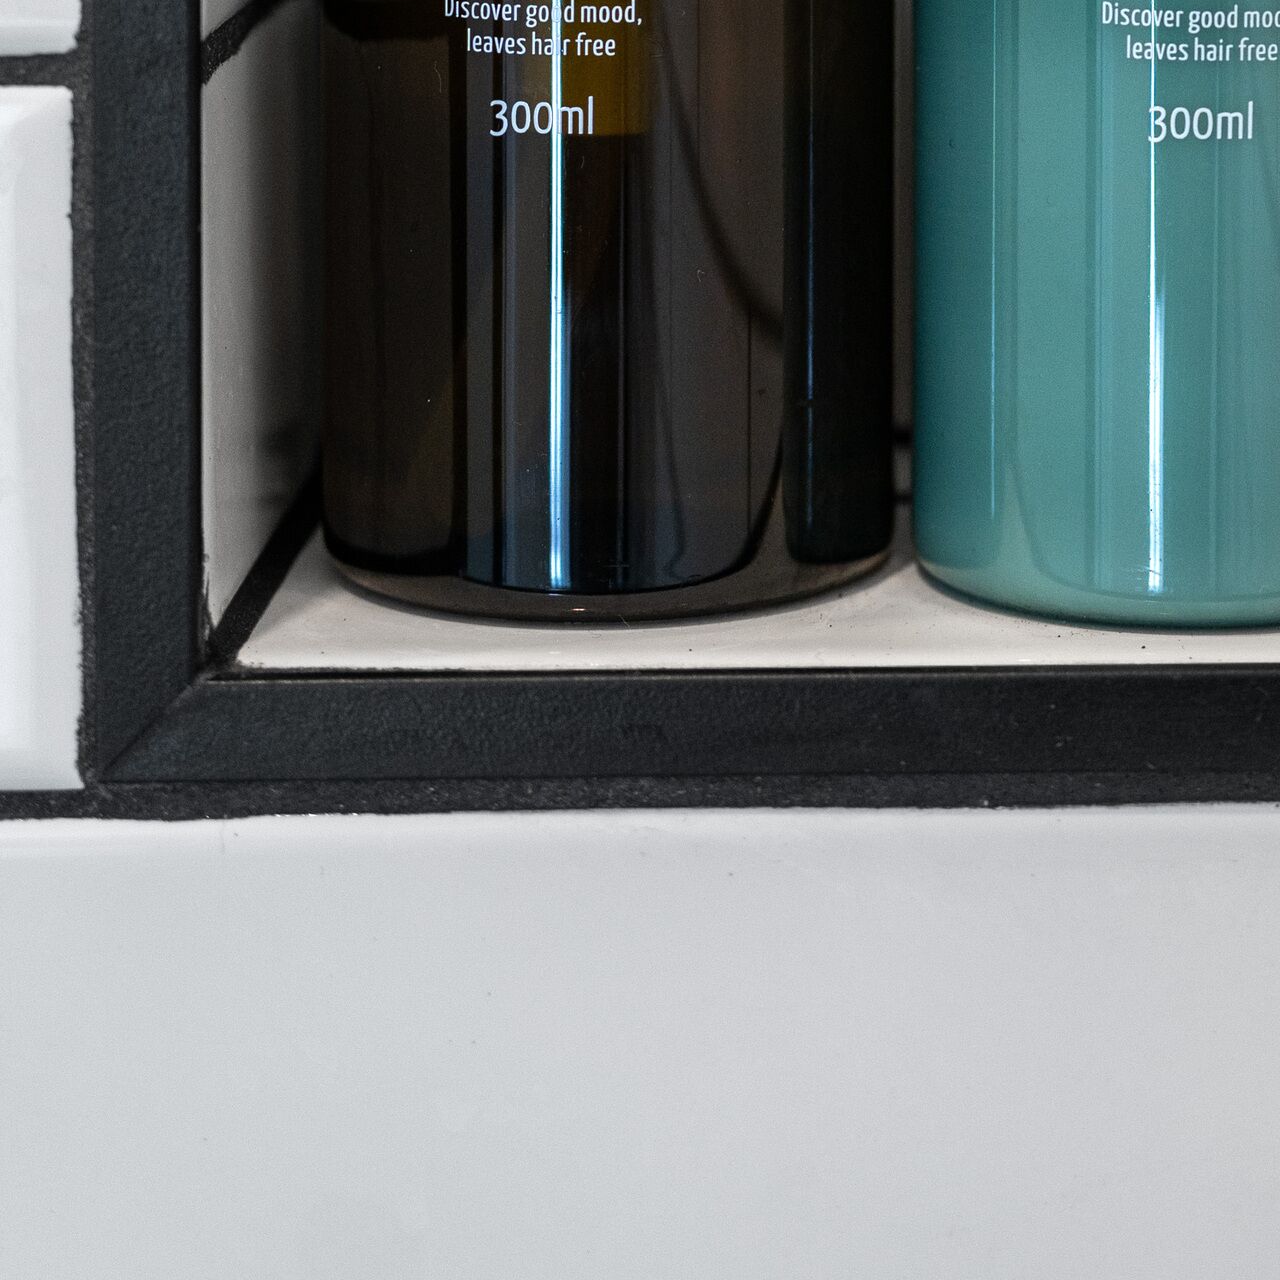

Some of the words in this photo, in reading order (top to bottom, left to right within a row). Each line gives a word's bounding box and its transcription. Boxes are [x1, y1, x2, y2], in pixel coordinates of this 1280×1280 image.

[1101, 0, 1184, 28] Discover
[1188, 4, 1239, 34] good
[466, 27, 527, 56] leaves
[575, 31, 617, 57] free
[1126, 34, 1189, 61] leaves
[1193, 37, 1234, 62] hair
[1238, 37, 1279, 62] free
[489, 95, 594, 137] 300ml
[1148, 100, 1254, 143] 300ml
